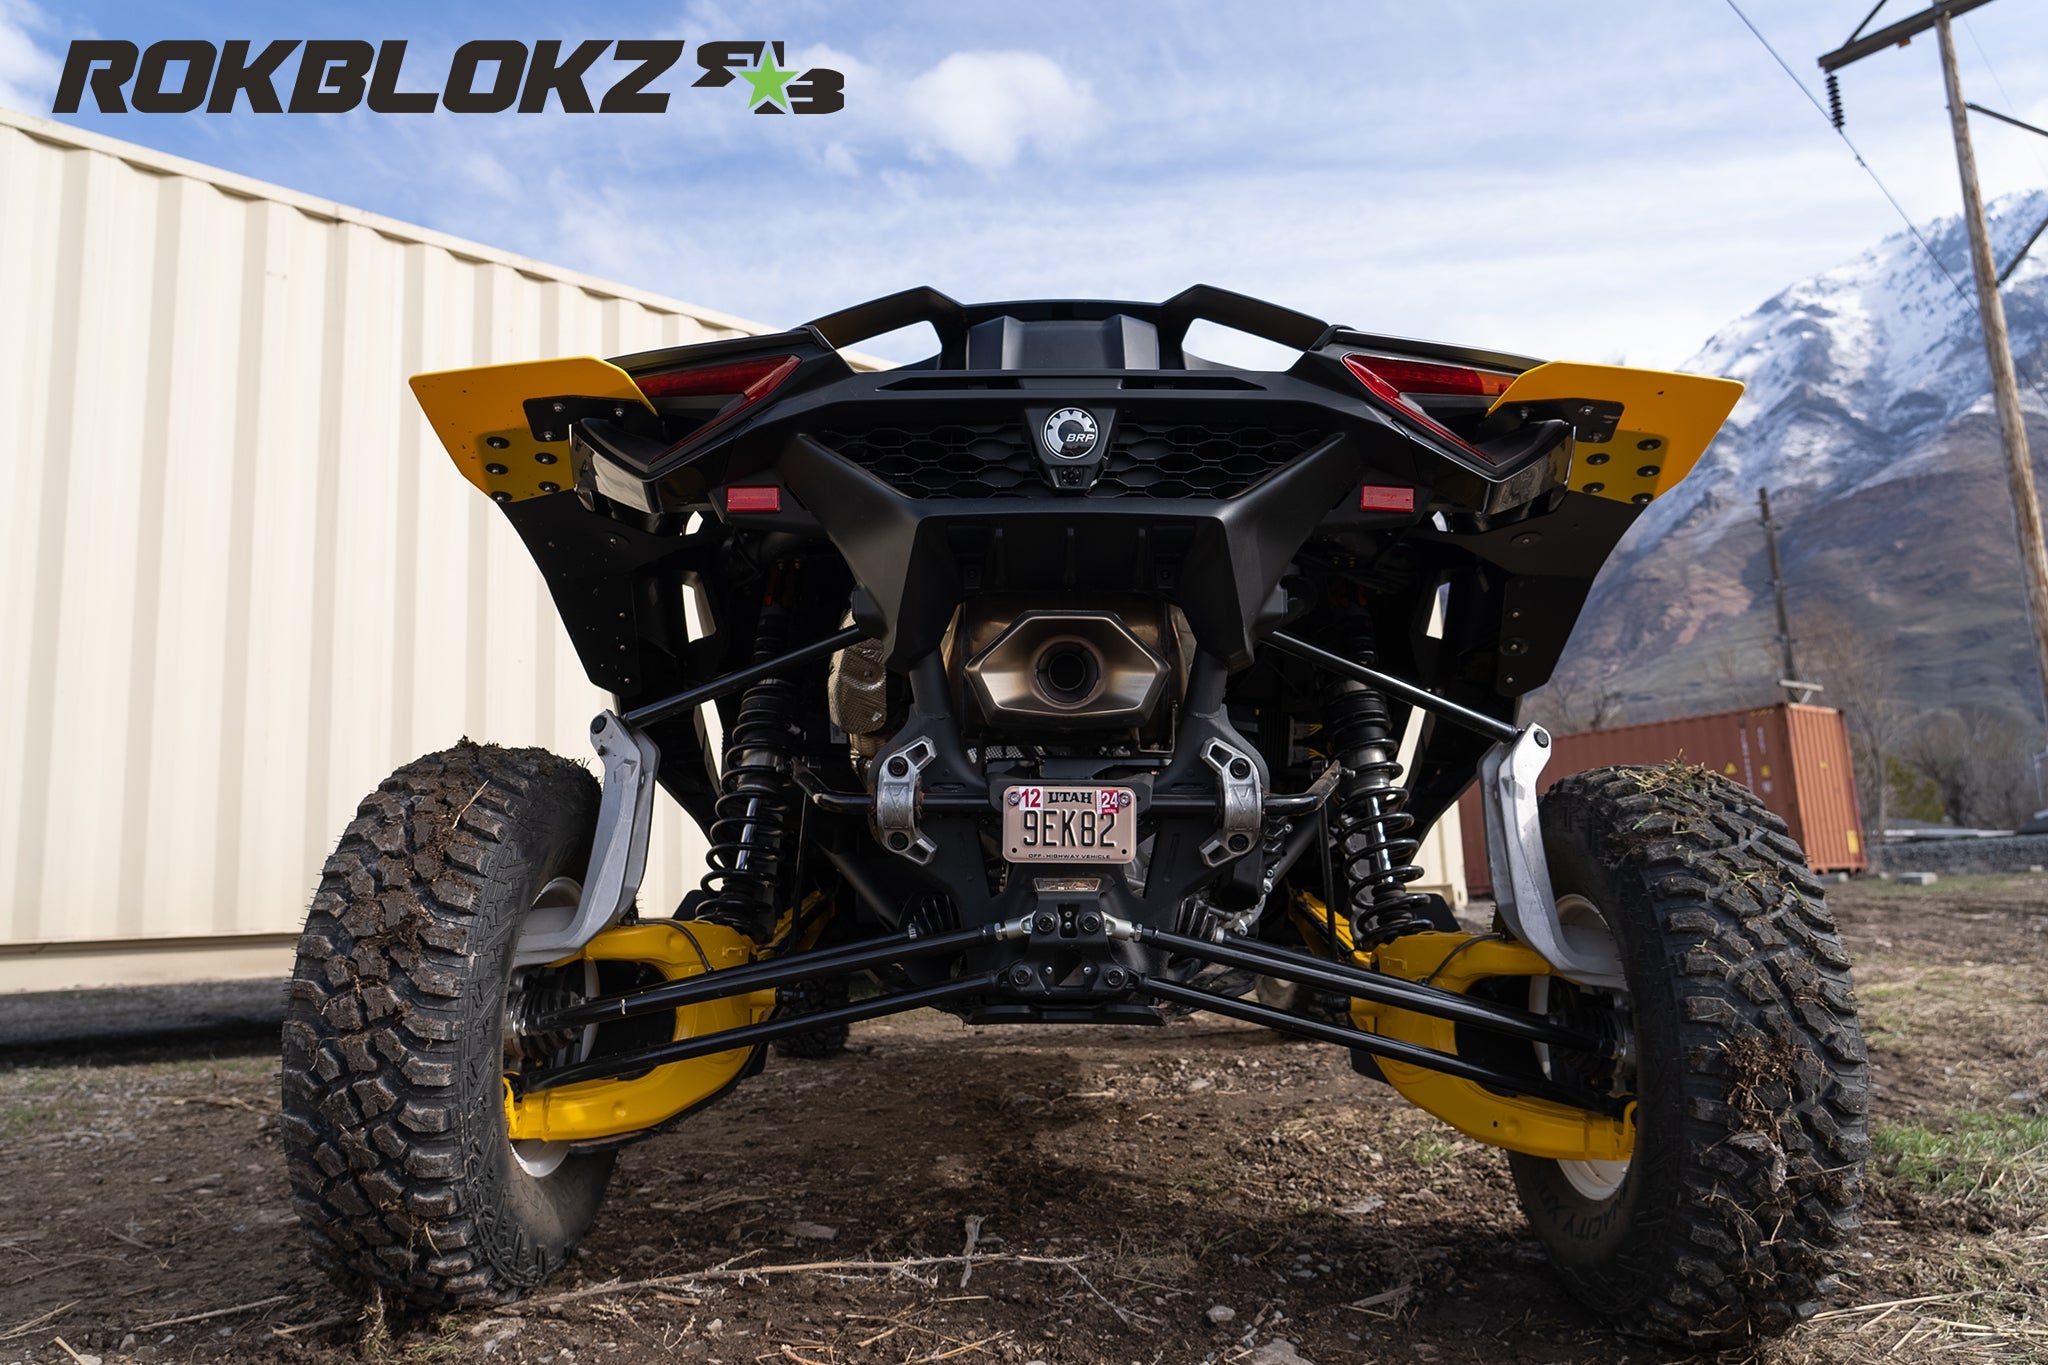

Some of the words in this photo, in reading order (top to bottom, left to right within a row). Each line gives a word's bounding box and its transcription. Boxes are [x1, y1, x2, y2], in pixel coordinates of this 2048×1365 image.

[1066, 433, 1095, 443] BRP
[1021, 788, 1041, 808] 12
[1048, 792, 1092, 804] UTAH
[1101, 792, 1119, 808] 24
[1023, 810, 1116, 847] 9EK82
